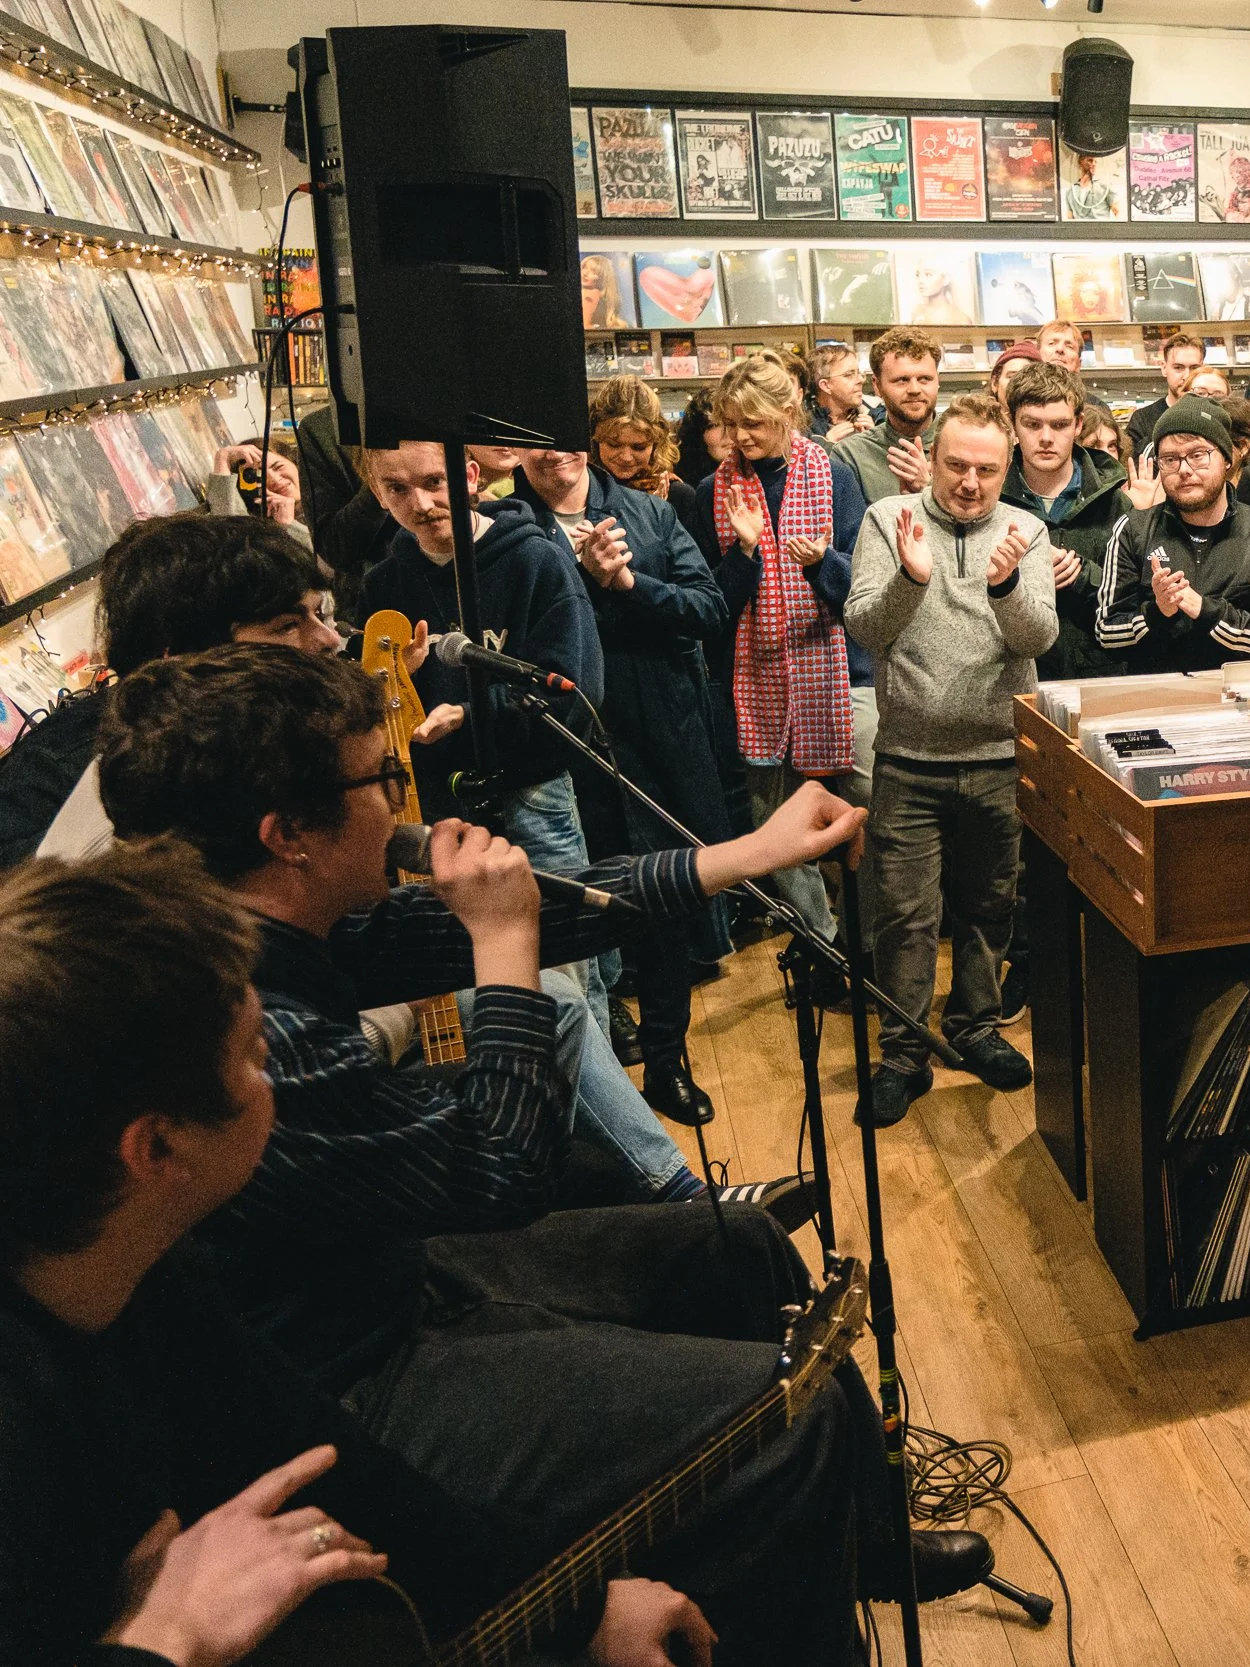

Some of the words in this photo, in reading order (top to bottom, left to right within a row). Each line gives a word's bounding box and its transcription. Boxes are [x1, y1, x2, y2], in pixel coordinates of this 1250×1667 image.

[848, 124, 893, 150] CATU
[1200, 134, 1226, 149] TALL
[605, 163, 667, 183] YOUR
[1158, 770, 1217, 788] HARRY
